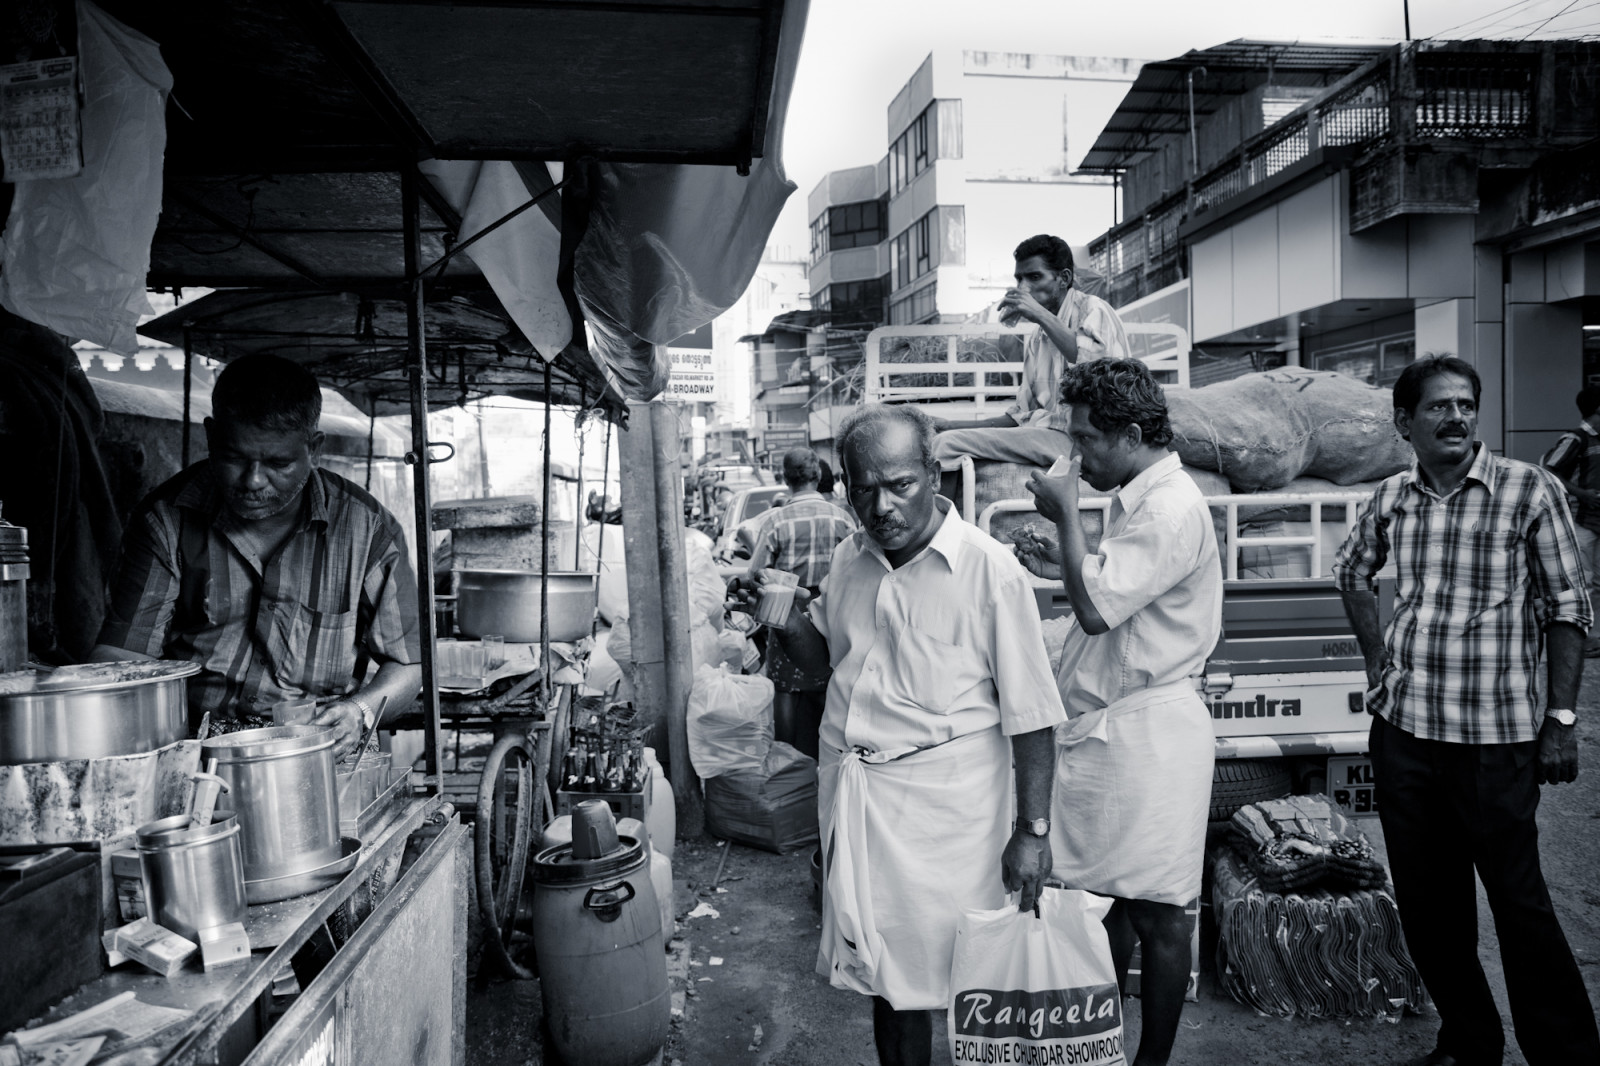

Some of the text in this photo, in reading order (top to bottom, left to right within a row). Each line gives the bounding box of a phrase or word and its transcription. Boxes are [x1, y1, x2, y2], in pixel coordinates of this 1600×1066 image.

[1321, 641, 1357, 657] HORN
[1205, 694, 1301, 719] indra
[1347, 765, 1375, 784] KL
[963, 993, 1115, 1038] Rangeela
[955, 1039, 1011, 1065] EXCLUSIVE
[1013, 1042, 1065, 1066] CHURIDAR
